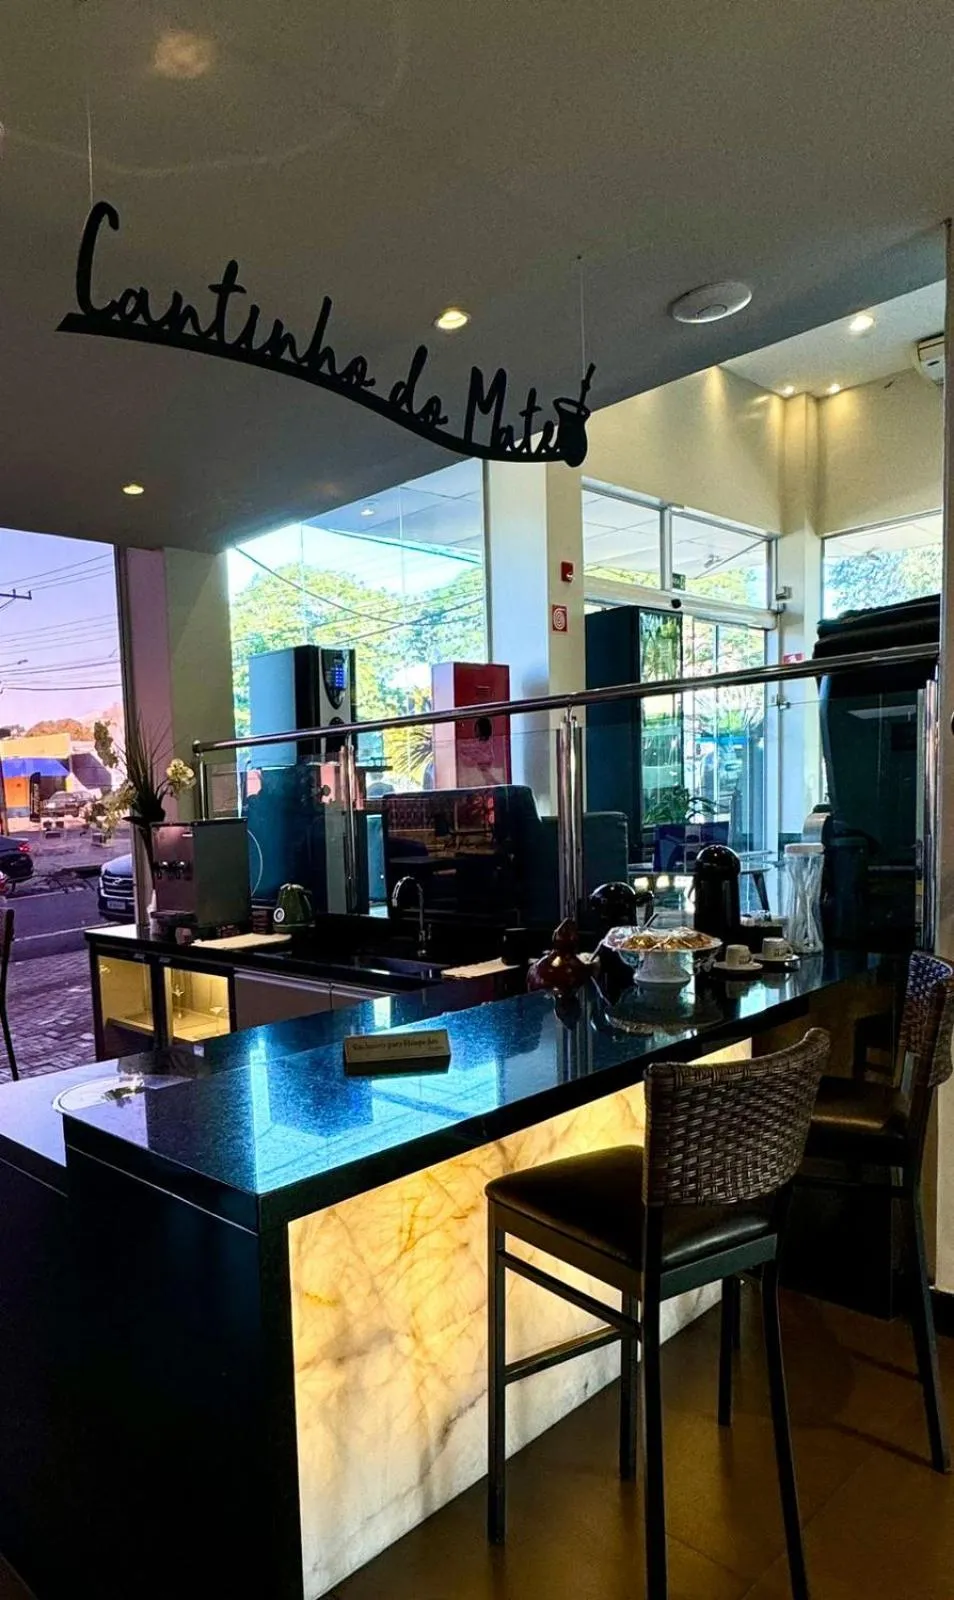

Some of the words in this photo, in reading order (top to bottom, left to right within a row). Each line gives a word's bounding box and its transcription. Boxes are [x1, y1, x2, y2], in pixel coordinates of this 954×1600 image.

[76, 201, 375, 390] Cantinho
[388, 345, 449, 426] do
[464, 365, 560, 454] Mate
